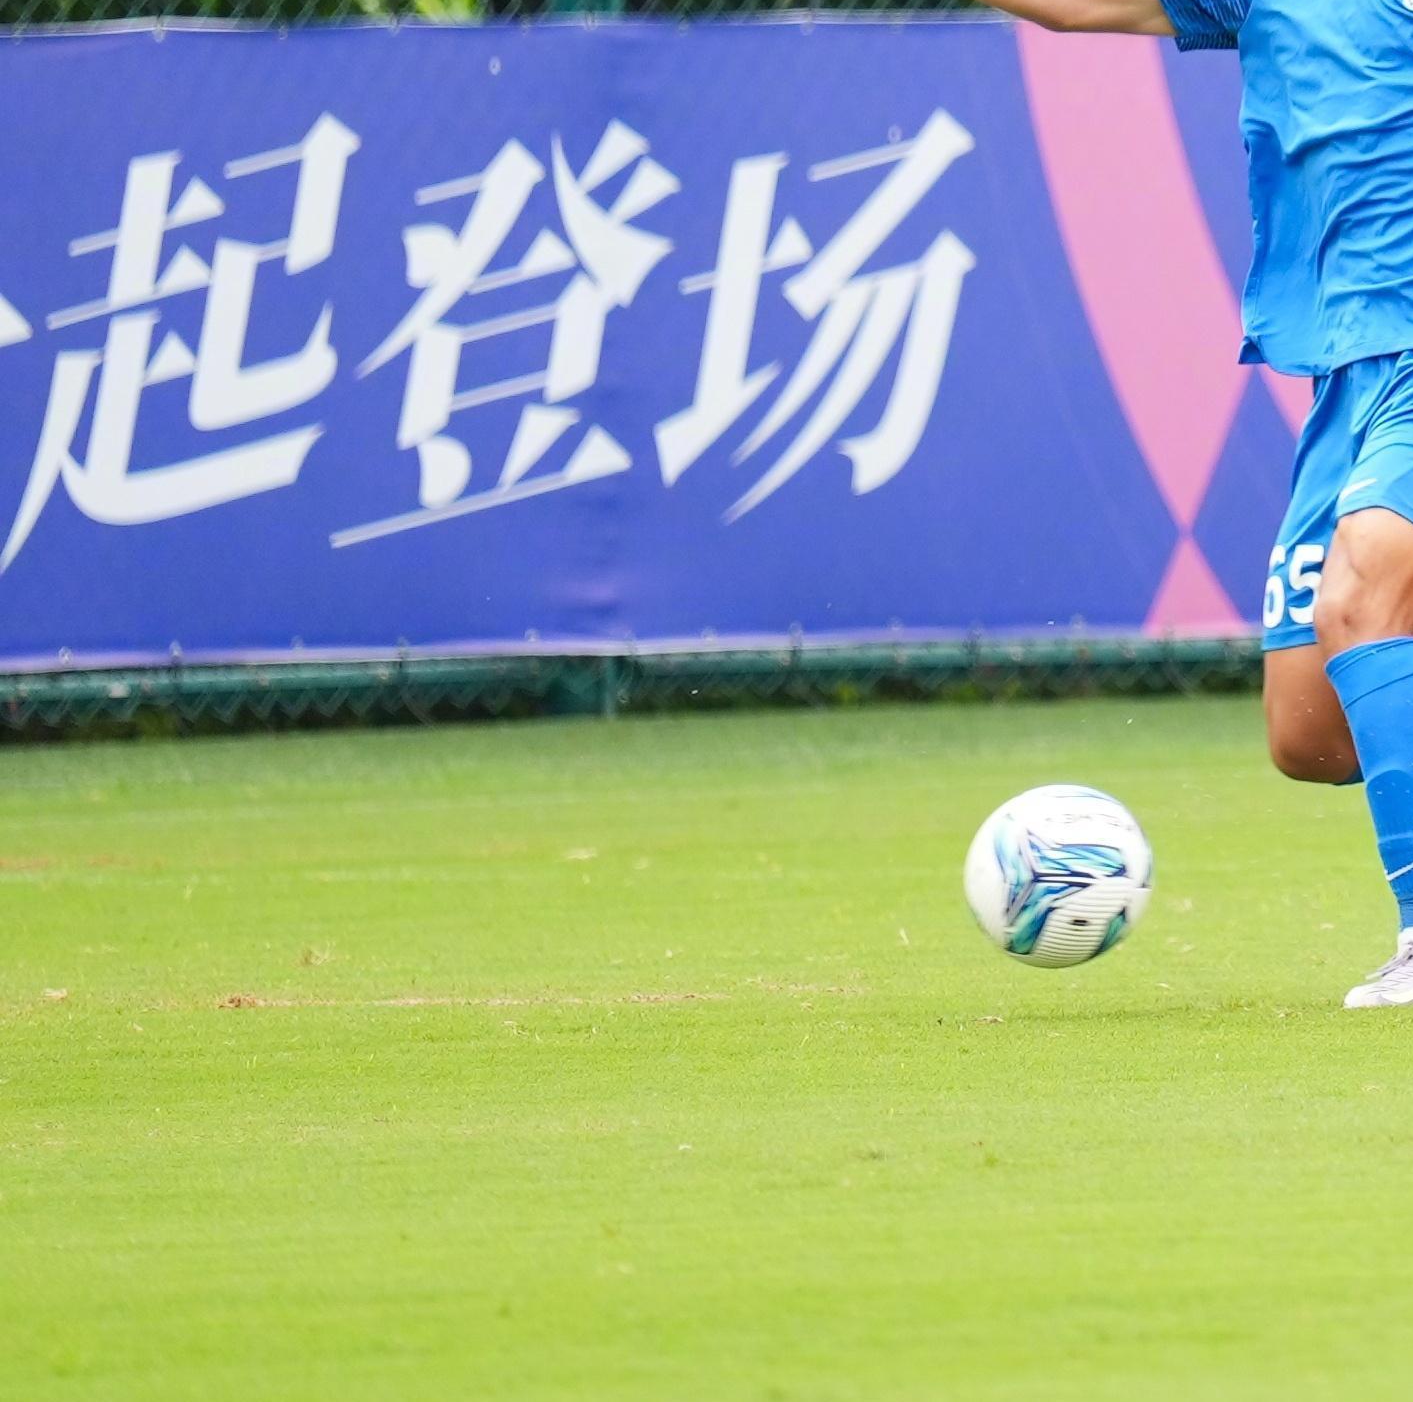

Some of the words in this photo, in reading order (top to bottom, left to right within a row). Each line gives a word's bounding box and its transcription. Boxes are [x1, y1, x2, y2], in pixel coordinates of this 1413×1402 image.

[0, 107, 977, 574] 起登场
[1263, 543, 1326, 629] 65
